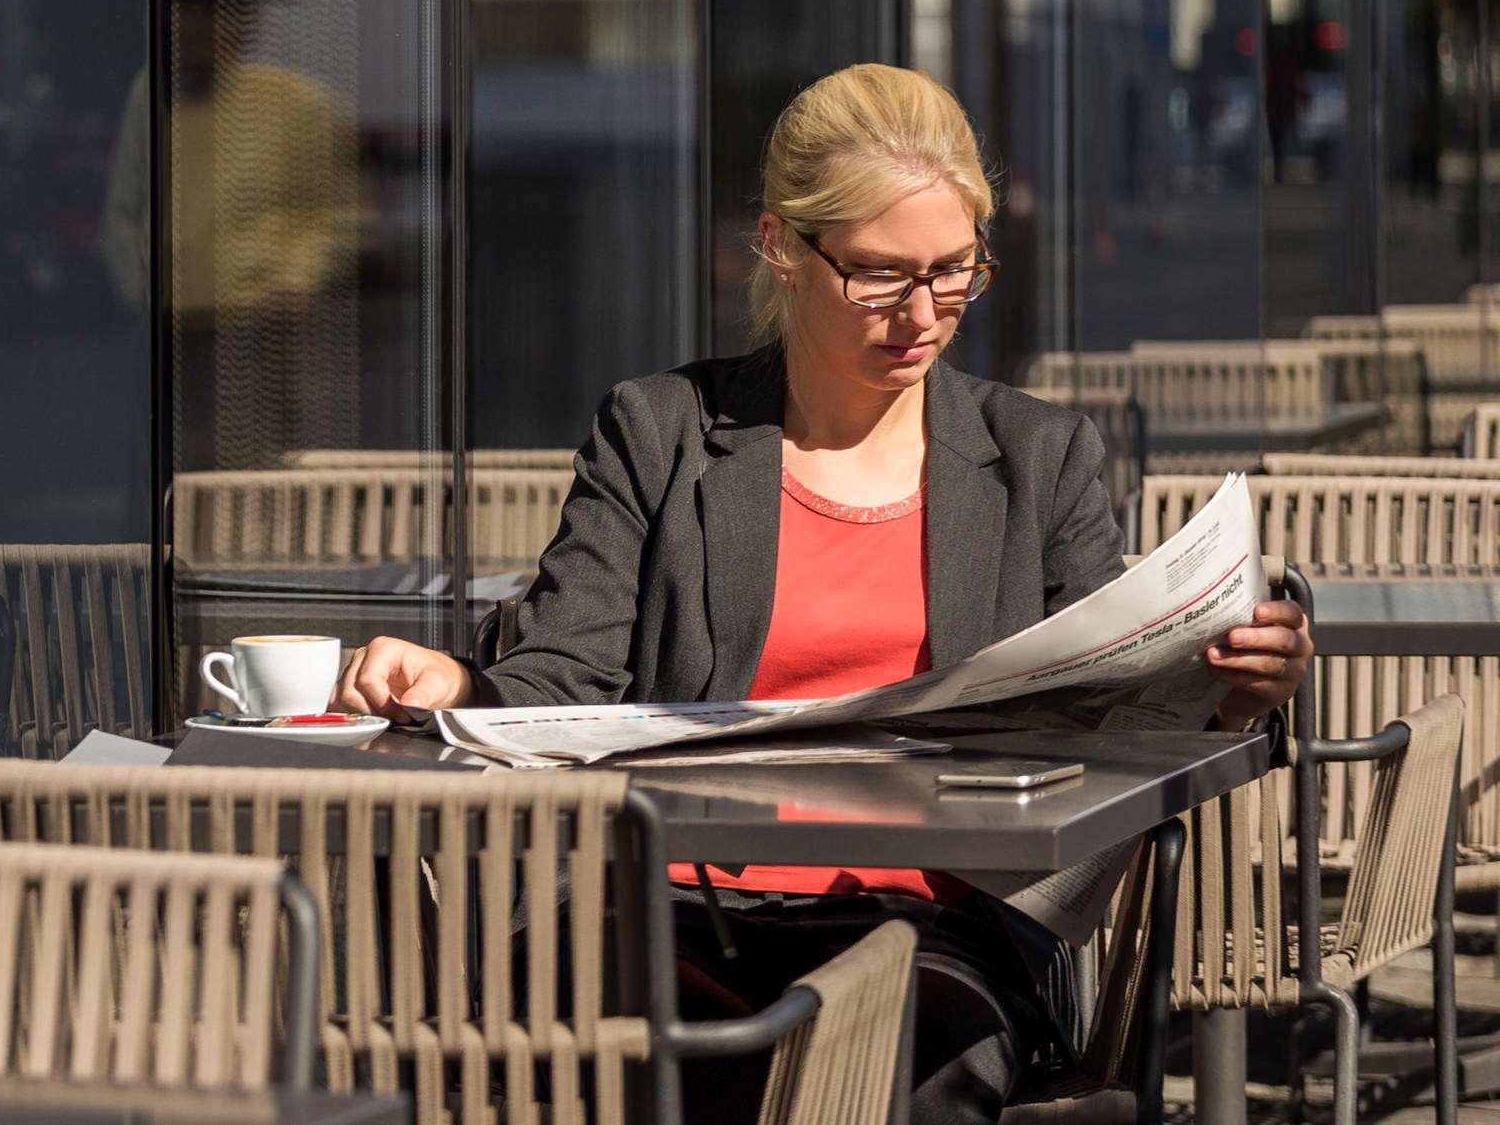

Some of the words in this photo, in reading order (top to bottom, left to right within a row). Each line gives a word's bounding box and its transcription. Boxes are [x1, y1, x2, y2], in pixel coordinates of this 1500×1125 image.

[1026, 658, 1093, 682] Aargauer
[1093, 640, 1138, 665] prüfen
[1141, 623, 1173, 644] Tesla
[1184, 594, 1221, 625] Basler
[1221, 573, 1243, 602] nicht
